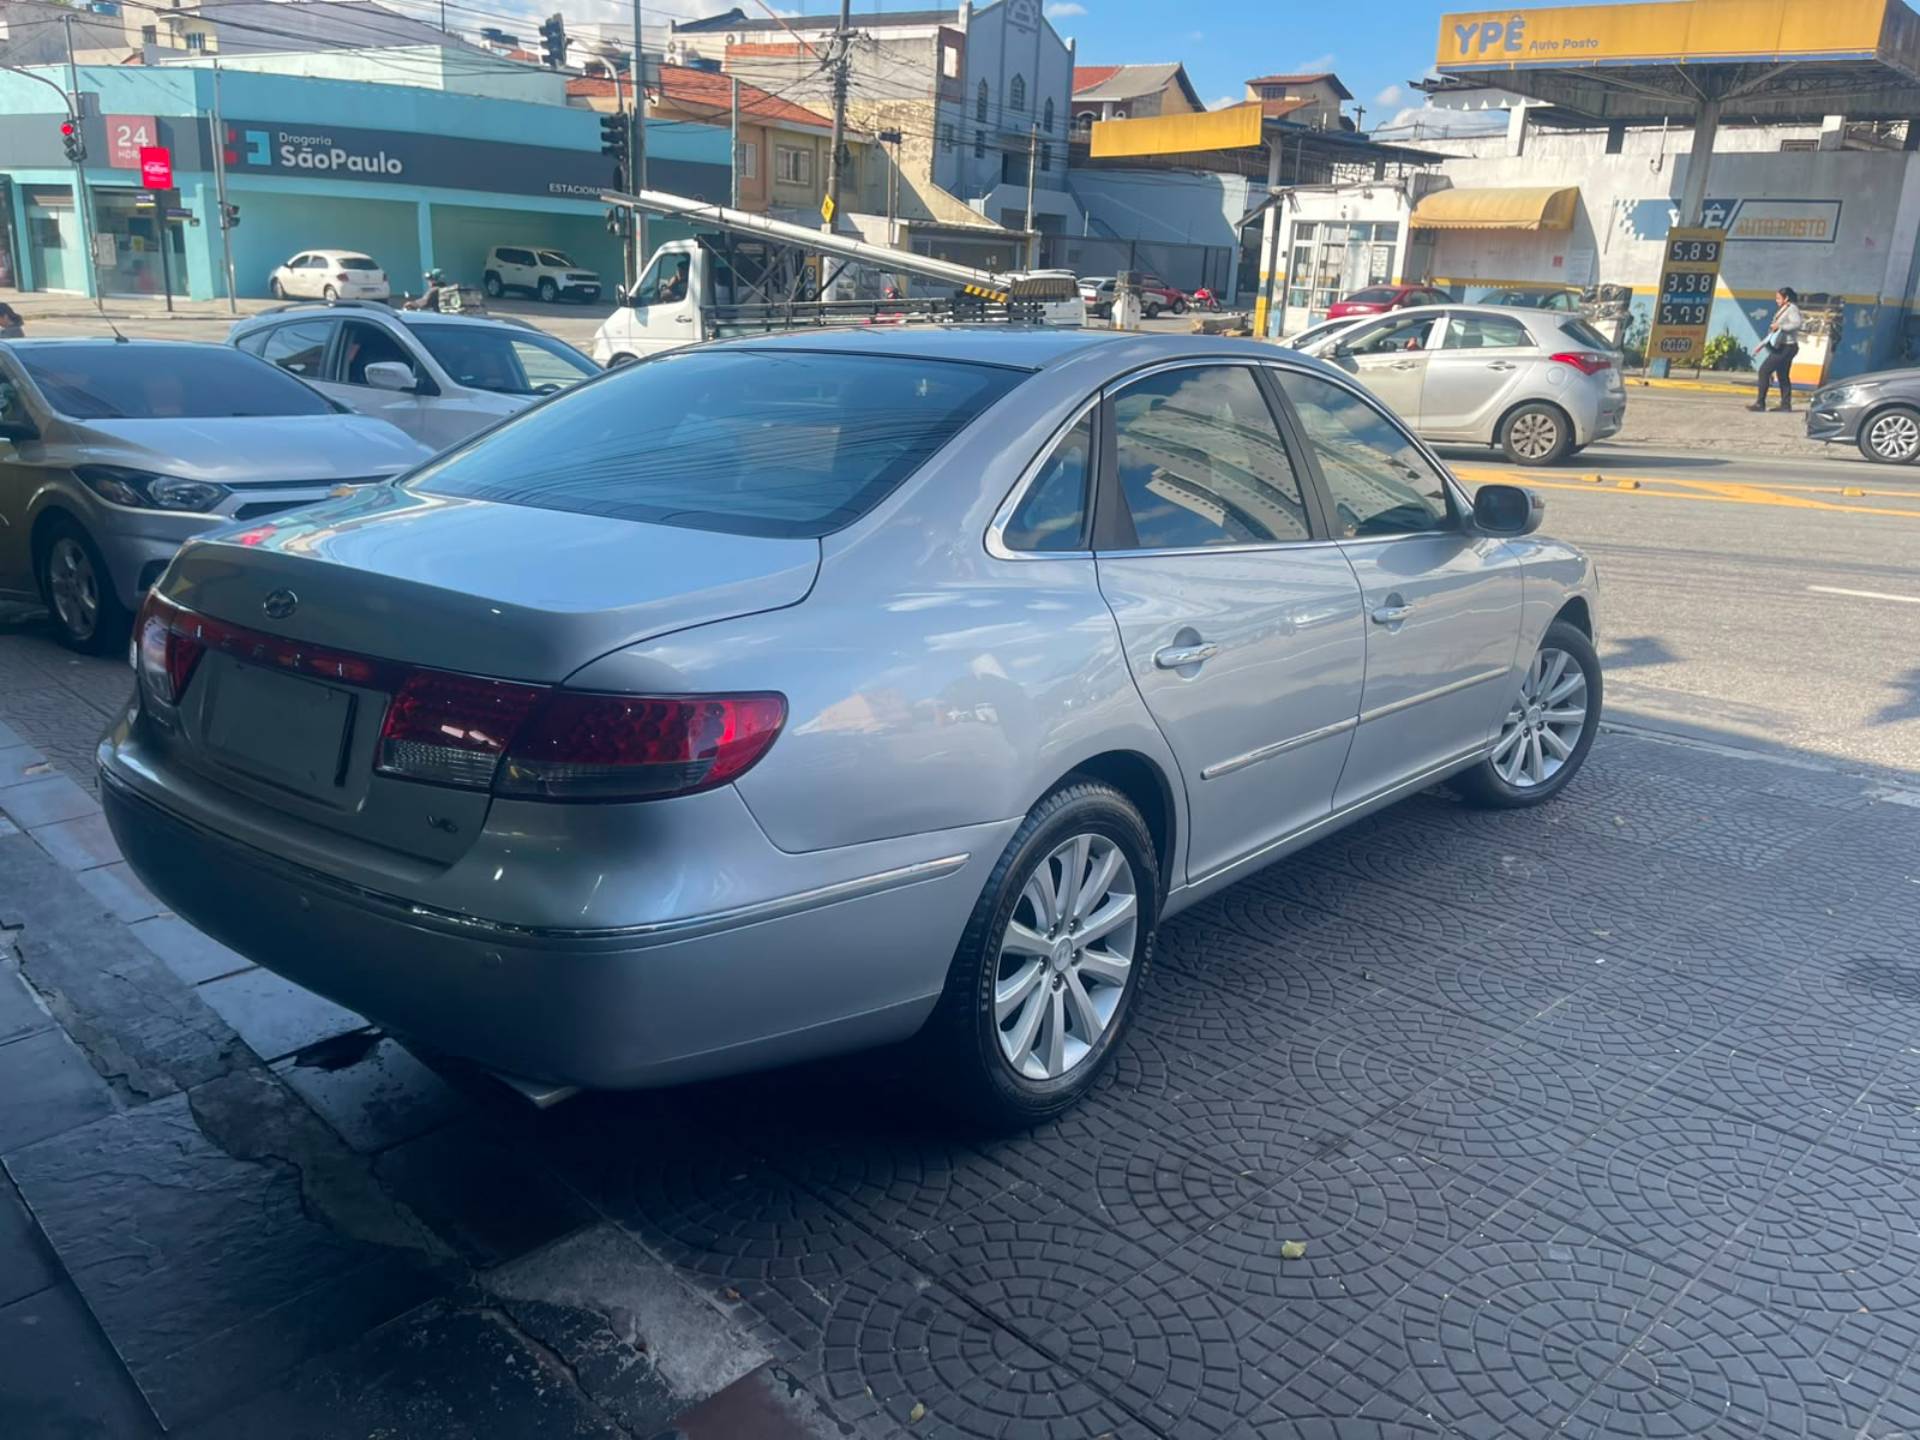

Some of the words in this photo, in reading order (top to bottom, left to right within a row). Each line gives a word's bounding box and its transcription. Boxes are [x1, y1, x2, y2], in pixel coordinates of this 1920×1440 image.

[1455, 14, 1526, 55] YPÊ
[1529, 39, 1559, 51] Auto
[1562, 38, 1600, 50] Posto
[117, 125, 149, 147] 24
[279, 131, 332, 146] Drogaria
[118, 150, 141, 160] HOR
[280, 144, 403, 174] SãoPaulo
[549, 183, 602, 195] ESTACIONA
[1672, 241, 1717, 260] 5,89
